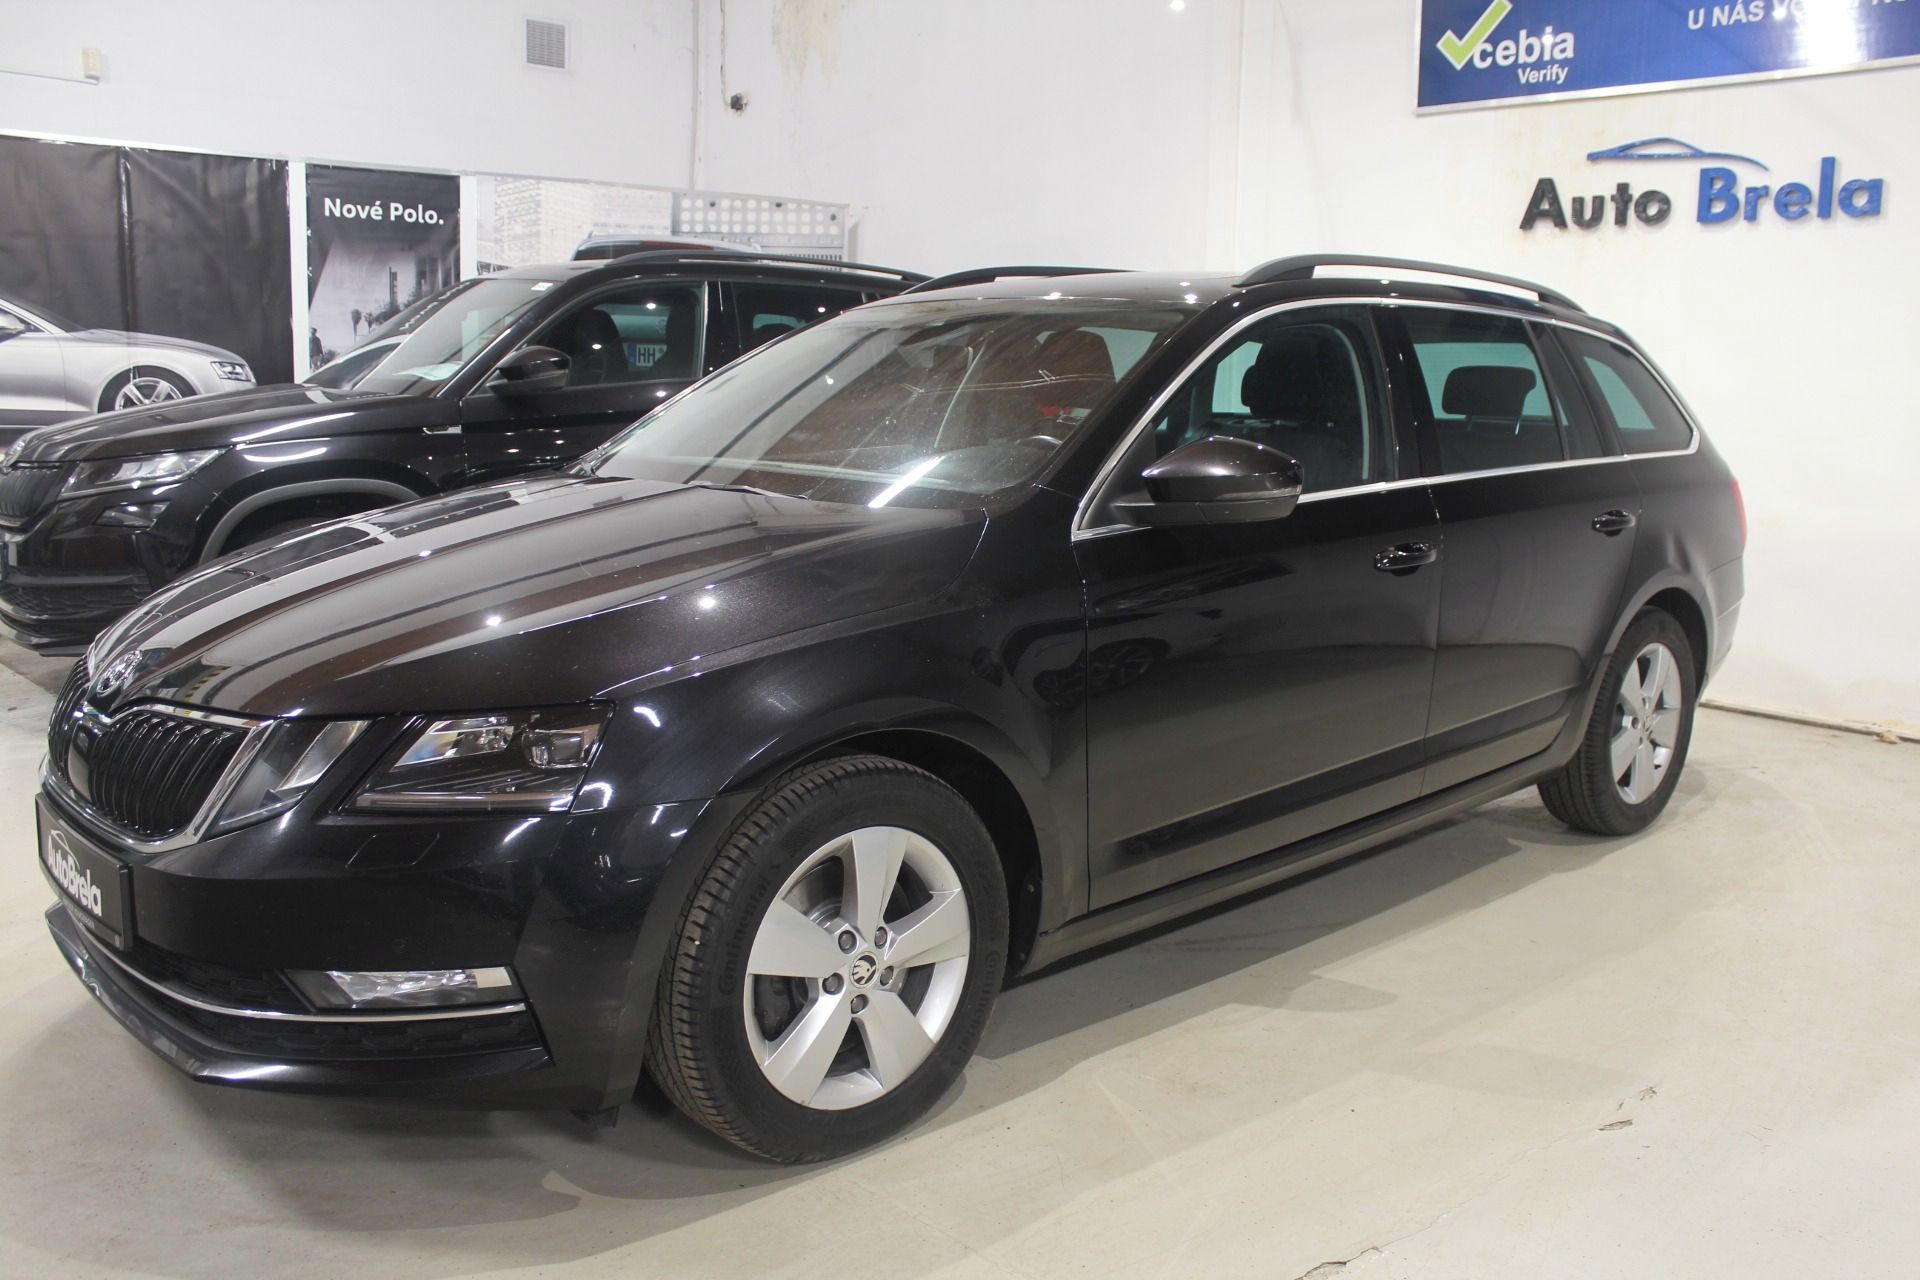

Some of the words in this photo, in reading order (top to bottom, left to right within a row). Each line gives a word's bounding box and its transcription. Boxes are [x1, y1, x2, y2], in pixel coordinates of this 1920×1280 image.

[1687, 8, 1705, 30] U
[1711, 0, 1764, 27] NÁS
[1473, 26, 1575, 69] cebia
[1517, 64, 1569, 85] Verify
[324, 197, 384, 221] Nové
[389, 202, 444, 225] Polo.
[1519, 177, 1672, 231] Auto
[1697, 156, 1885, 224] Brela
[48, 834, 103, 917] AutoBrela
